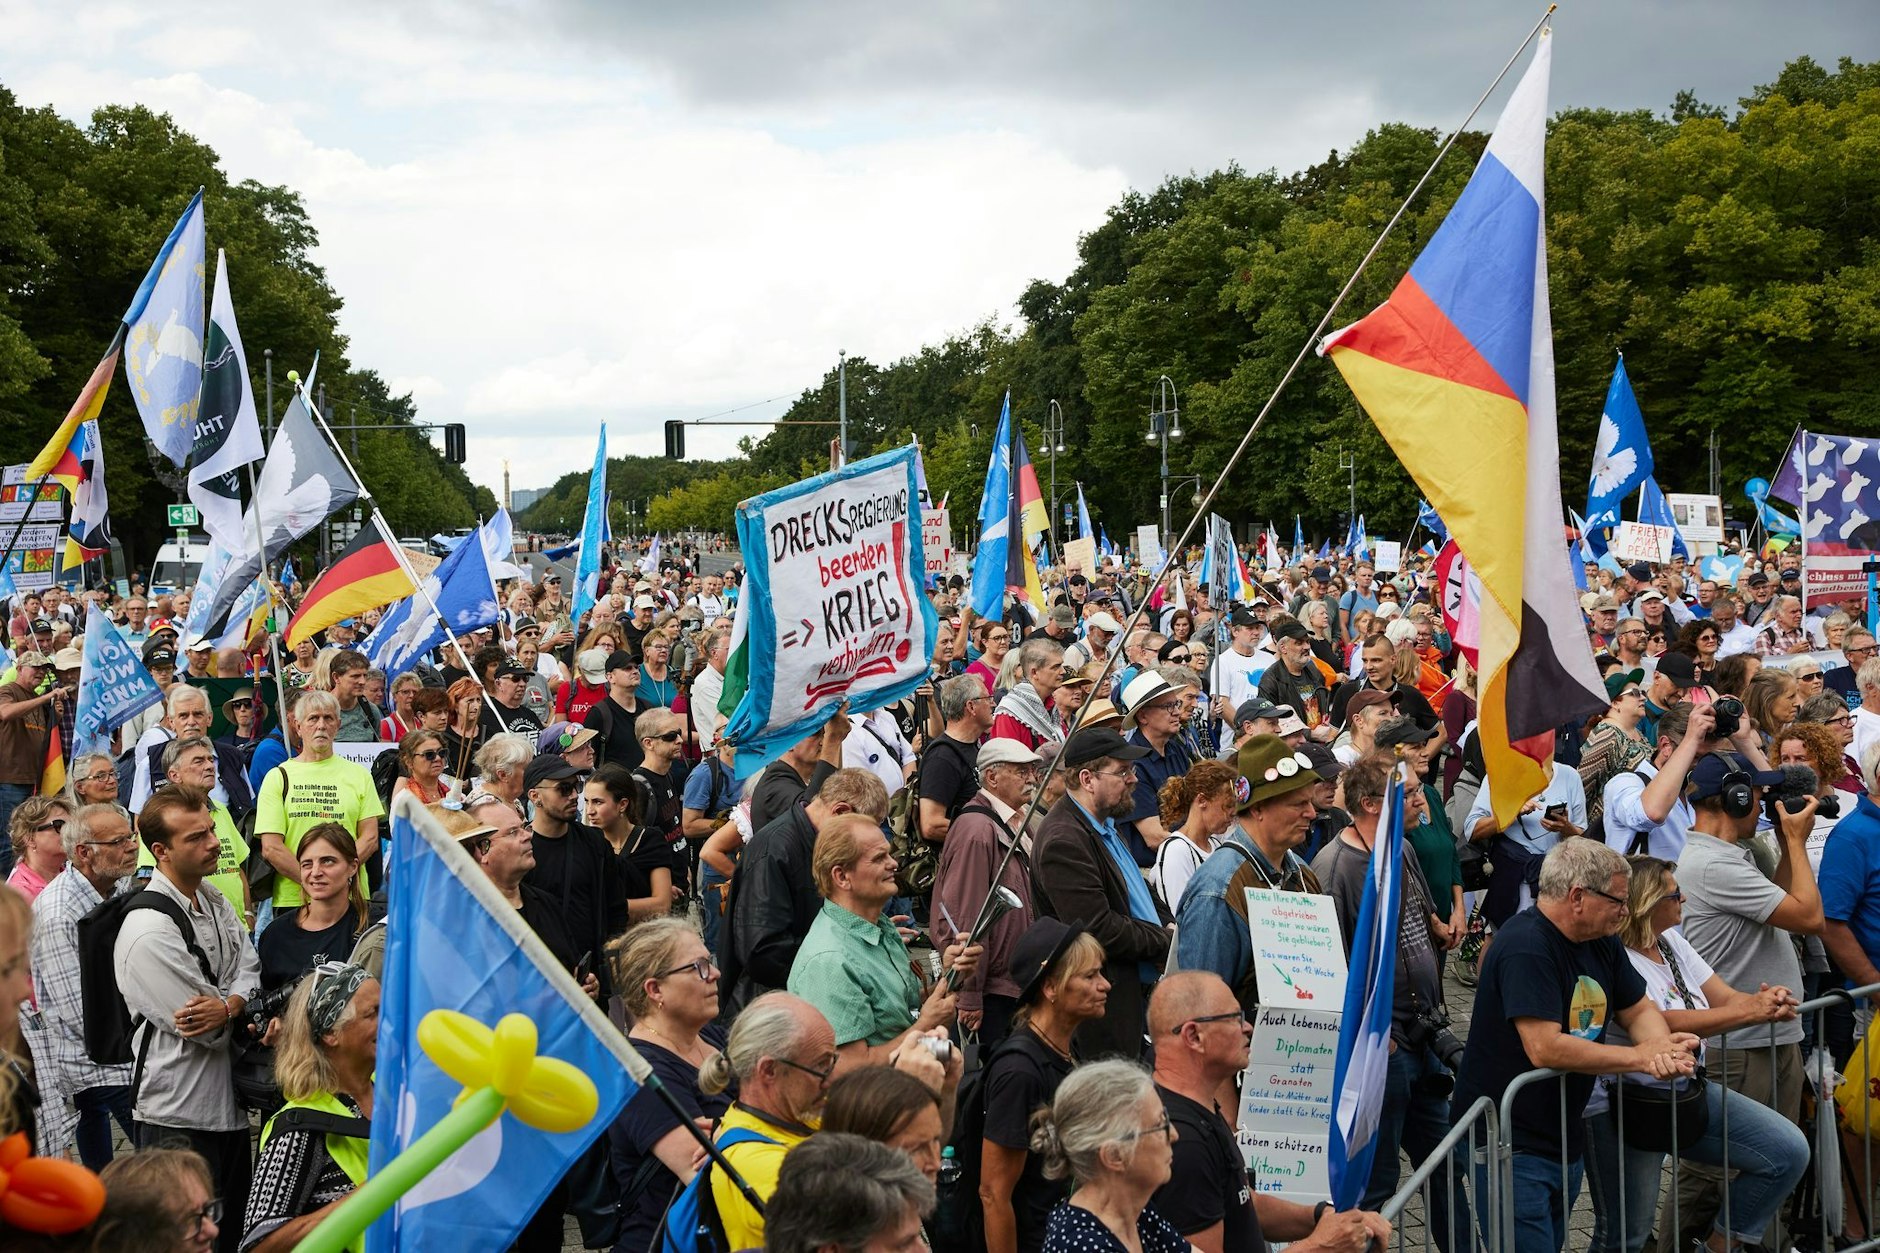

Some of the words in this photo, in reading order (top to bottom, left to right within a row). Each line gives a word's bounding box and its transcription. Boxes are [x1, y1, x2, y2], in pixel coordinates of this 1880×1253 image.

[21, 534, 53, 542] WAFFEN
[931, 530, 941, 545] in
[1629, 524, 1669, 539] FRIEDEN
[1627, 544, 1660, 558] PEACE
[817, 540, 887, 588] beenden
[1807, 571, 1844, 582] chluss
[1847, 571, 1868, 580] mit
[1808, 583, 1869, 594] remdbesti
[821, 570, 901, 649] KRIEG
[1271, 906, 1318, 921] abgetrieben
[1277, 920, 1290, 929] mir
[1277, 932, 1291, 944] Sie
[1259, 1011, 1286, 1026] Auch
[1275, 1038, 1333, 1059] Diplomaten
[1289, 1062, 1315, 1074] statt
[1269, 1074, 1313, 1088] Granaten
[1249, 1087, 1269, 1098] Geld
[1274, 1089, 1285, 1099] für
[1285, 1090, 1312, 1102] Mütter
[1315, 1094, 1329, 1104] und
[1247, 1103, 1270, 1115] Kinder
[1272, 1105, 1294, 1117] statt
[1295, 1107, 1309, 1118] für
[1310, 1108, 1331, 1124] Krieg
[1240, 1132, 1270, 1148] Leben
[1274, 1138, 1323, 1155] schützen
[1251, 1154, 1292, 1176] Vitamin
[1295, 1159, 1306, 1177] D
